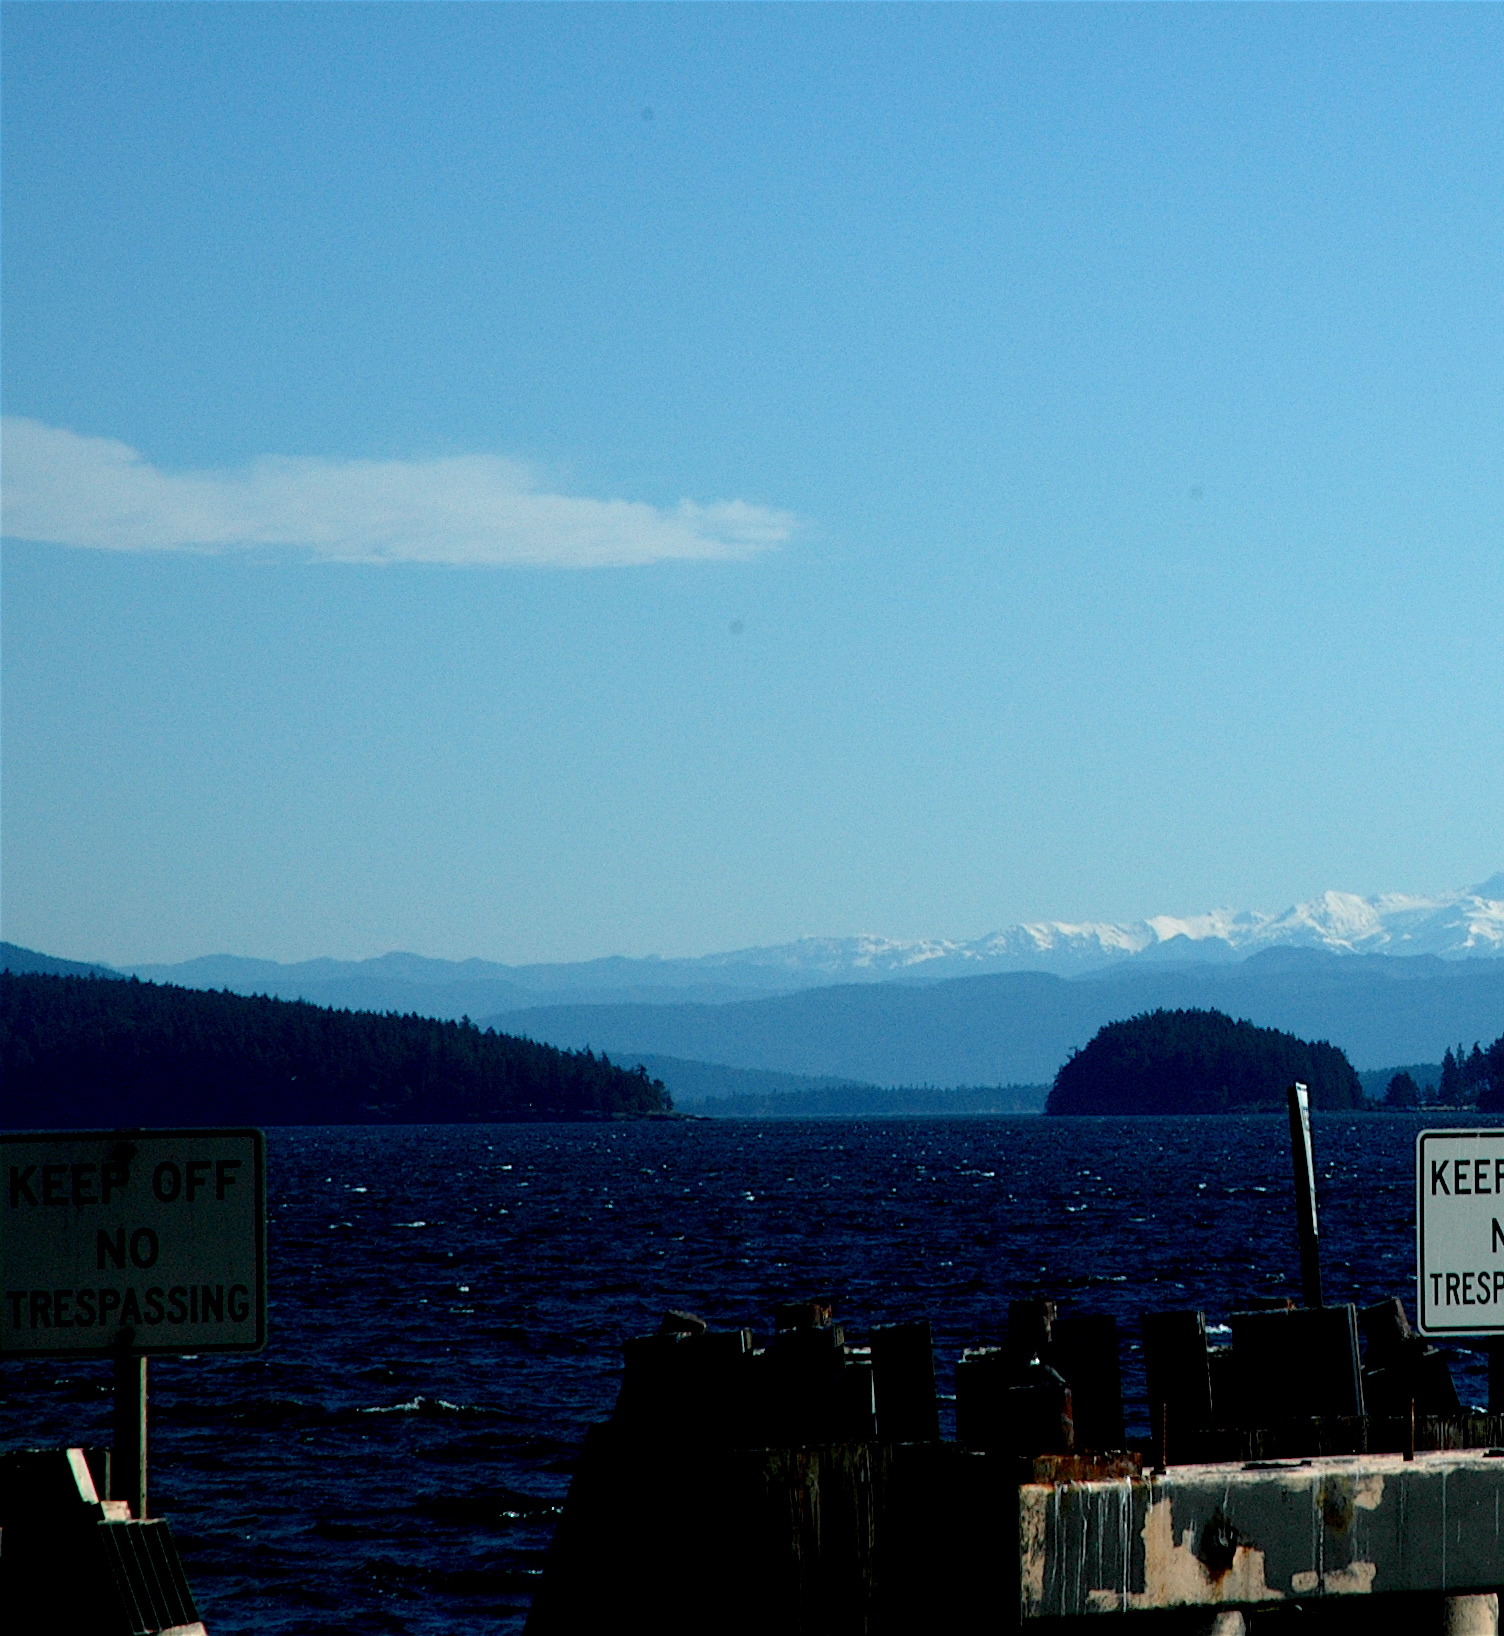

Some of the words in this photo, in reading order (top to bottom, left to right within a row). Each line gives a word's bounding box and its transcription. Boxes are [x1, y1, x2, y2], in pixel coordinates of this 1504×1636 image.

[9, 1162, 130, 1207] KEEP
[152, 1161, 242, 1203] OFF
[96, 1227, 159, 1270] NO
[6, 1284, 250, 1329] TRESPASSING
